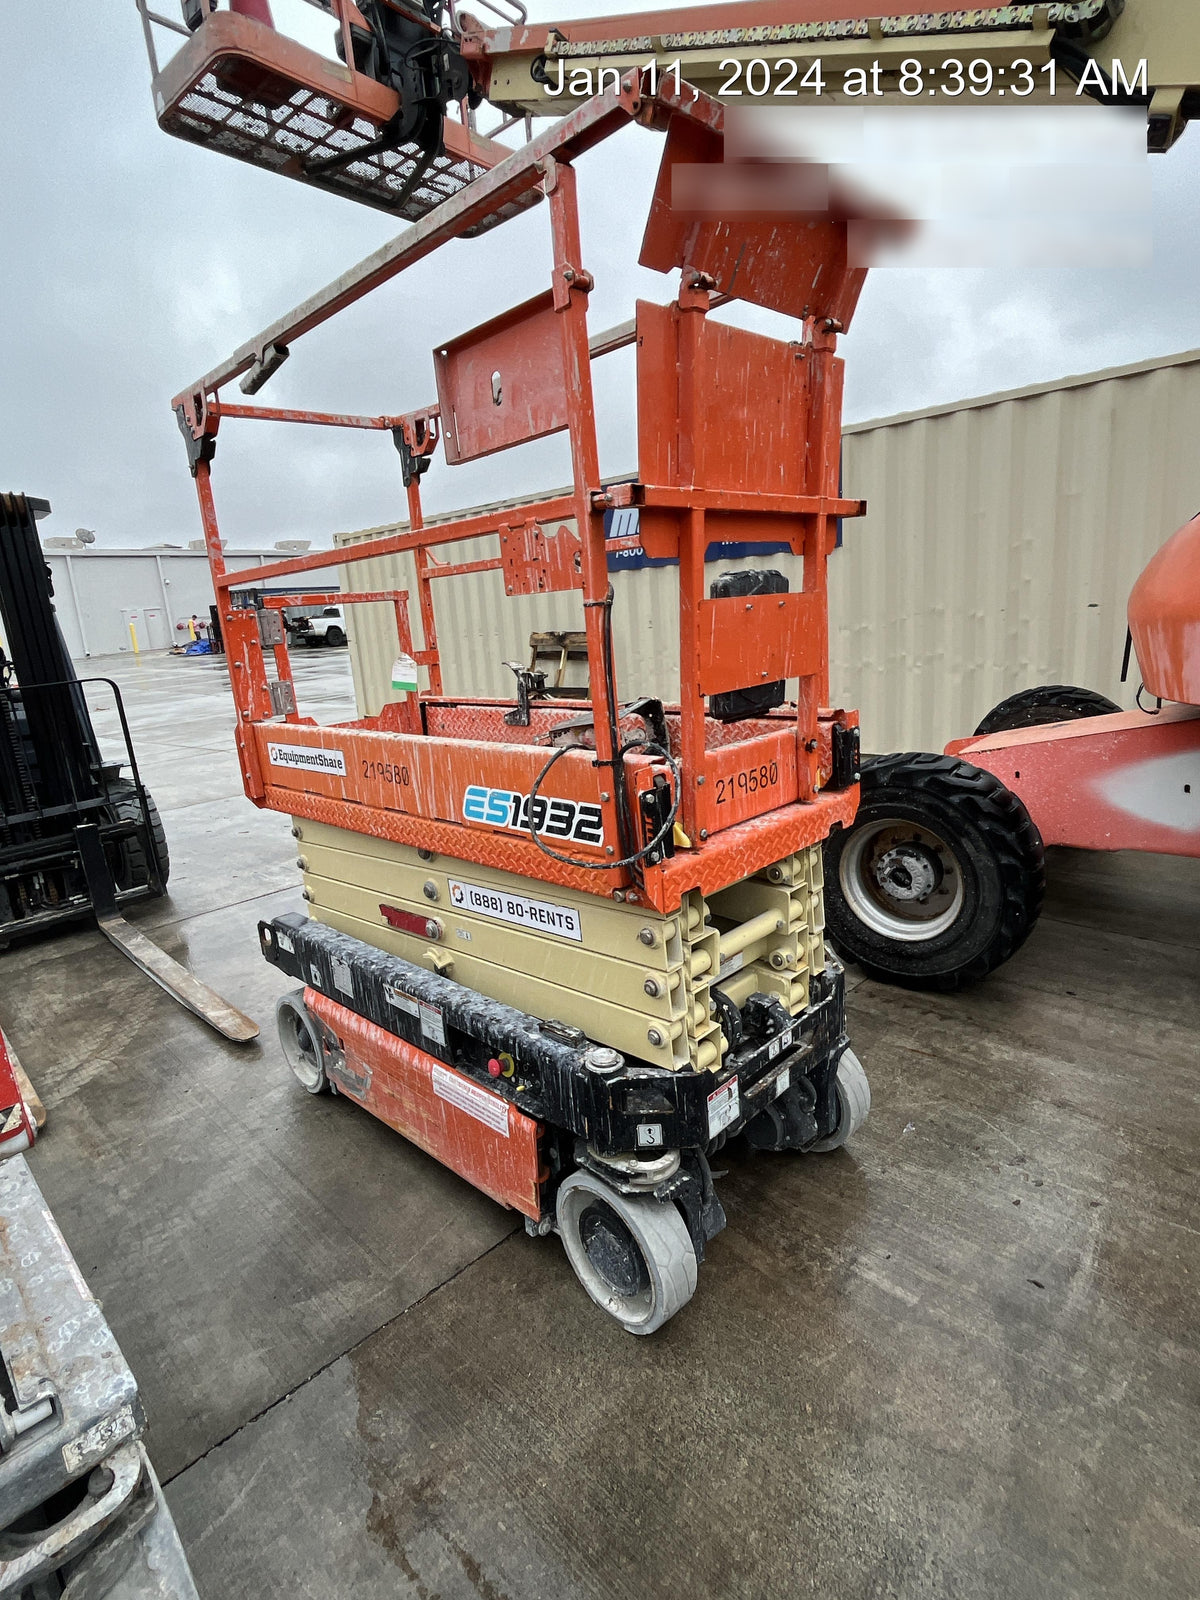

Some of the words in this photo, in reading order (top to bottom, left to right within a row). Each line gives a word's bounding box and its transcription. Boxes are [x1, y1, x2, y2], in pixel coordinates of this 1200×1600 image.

[362, 760, 410, 786] 219580
[715, 762, 778, 805] 219580
[464, 787, 604, 844] ES1932
[469, 890, 503, 913] (888)
[507, 901, 575, 931] 80-RENTS
